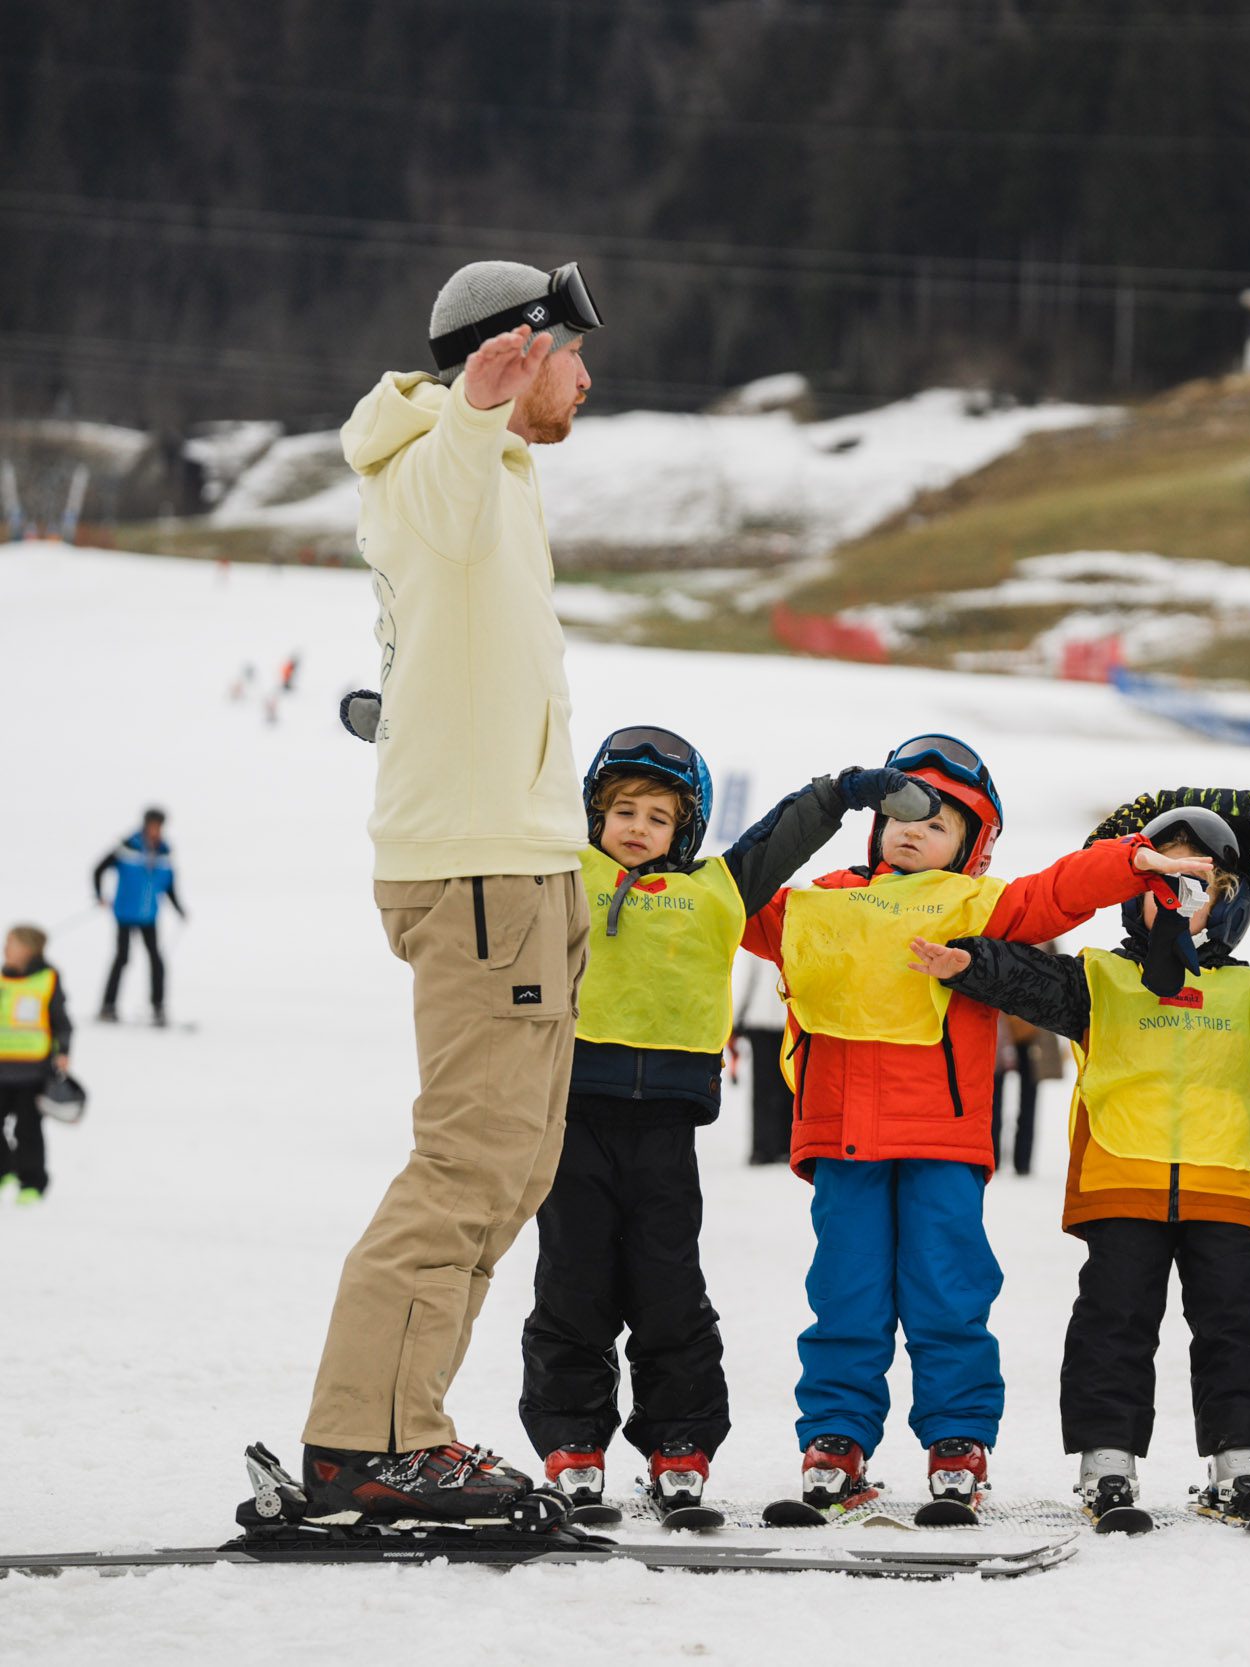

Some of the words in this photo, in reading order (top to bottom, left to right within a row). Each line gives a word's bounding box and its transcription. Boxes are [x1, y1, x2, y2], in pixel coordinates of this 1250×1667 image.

[596, 893, 639, 907] SNW
[653, 895, 695, 911] TRIBE
[848, 891, 890, 910] SNOW
[1139, 1015, 1180, 1031] SNOW
[1194, 1015, 1232, 1031] TRIBE
